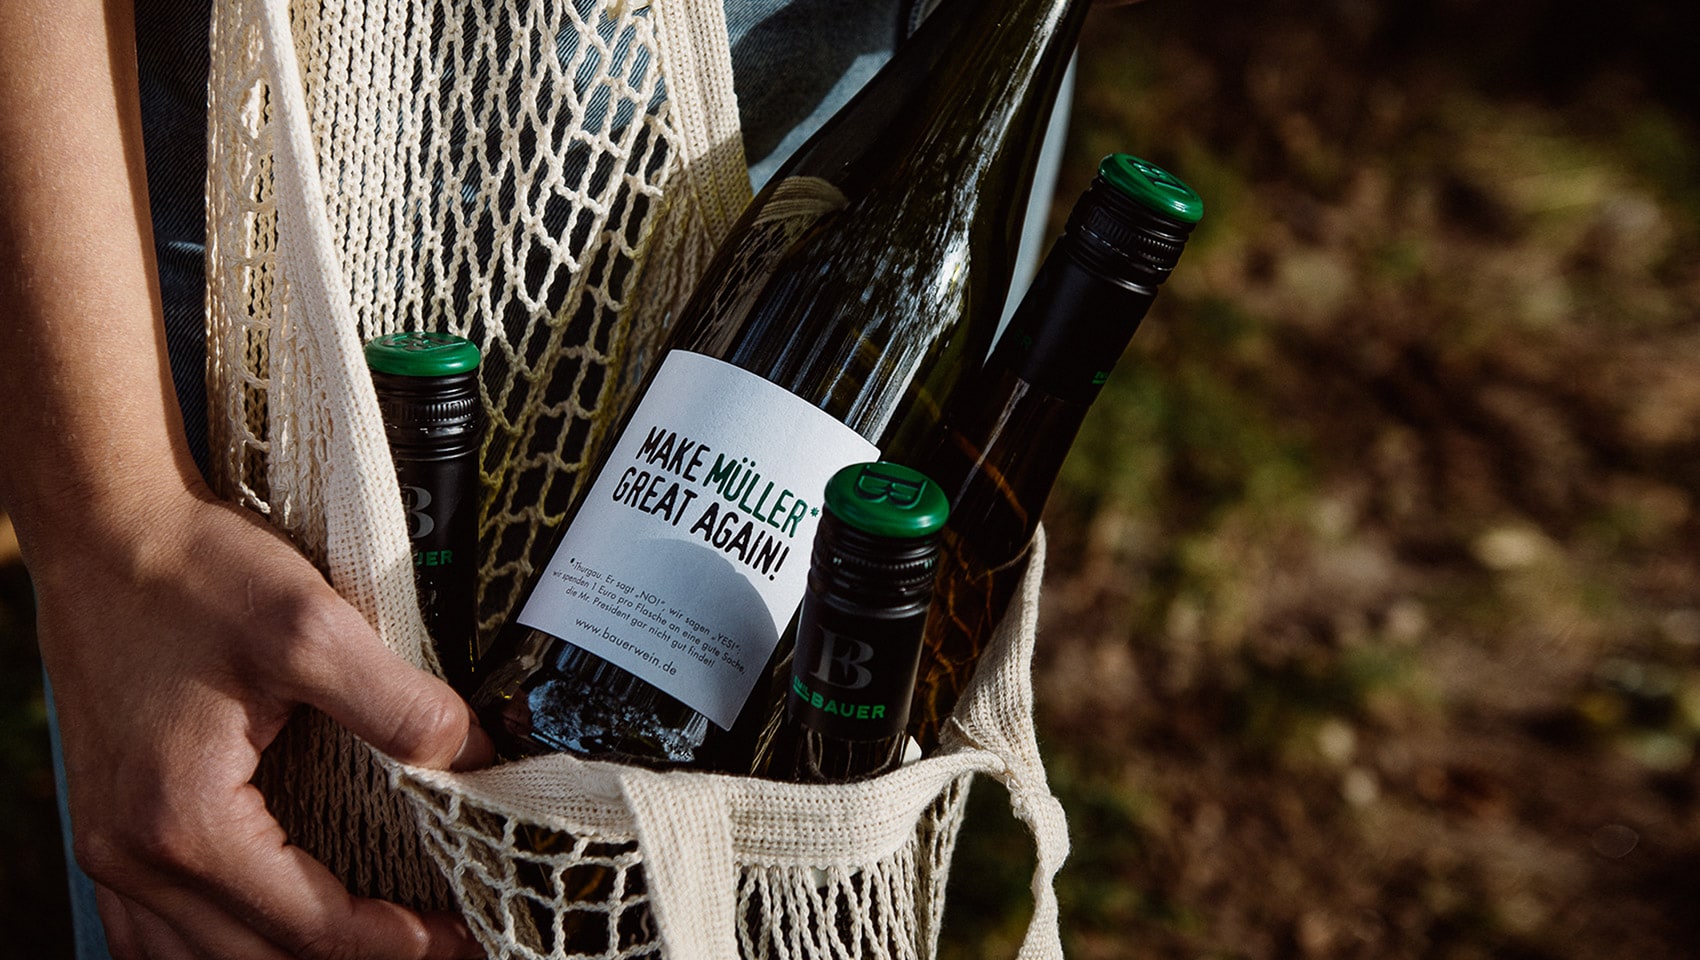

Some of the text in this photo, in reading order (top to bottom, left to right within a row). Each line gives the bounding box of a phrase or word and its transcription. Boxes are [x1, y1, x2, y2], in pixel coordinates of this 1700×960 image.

[636, 426, 711, 482] MAKE
[612, 466, 790, 581] GREAT AGAIN!
[562, 573, 590, 589] spenden
[598, 585, 617, 600] Euro
[617, 597, 634, 608] pro
[635, 602, 668, 626] Flasche
[668, 623, 681, 634] an
[682, 631, 701, 645] eine
[701, 642, 721, 657] gute
[565, 585, 716, 668] die Mr. President gar nicht gut findet!
[605, 574, 615, 584] Er
[616, 581, 635, 595] sagt
[669, 607, 683, 619] wir
[685, 617, 711, 635] sagen
[575, 618, 677, 676] www.bauerwein.de
[810, 691, 886, 719] BAUER
